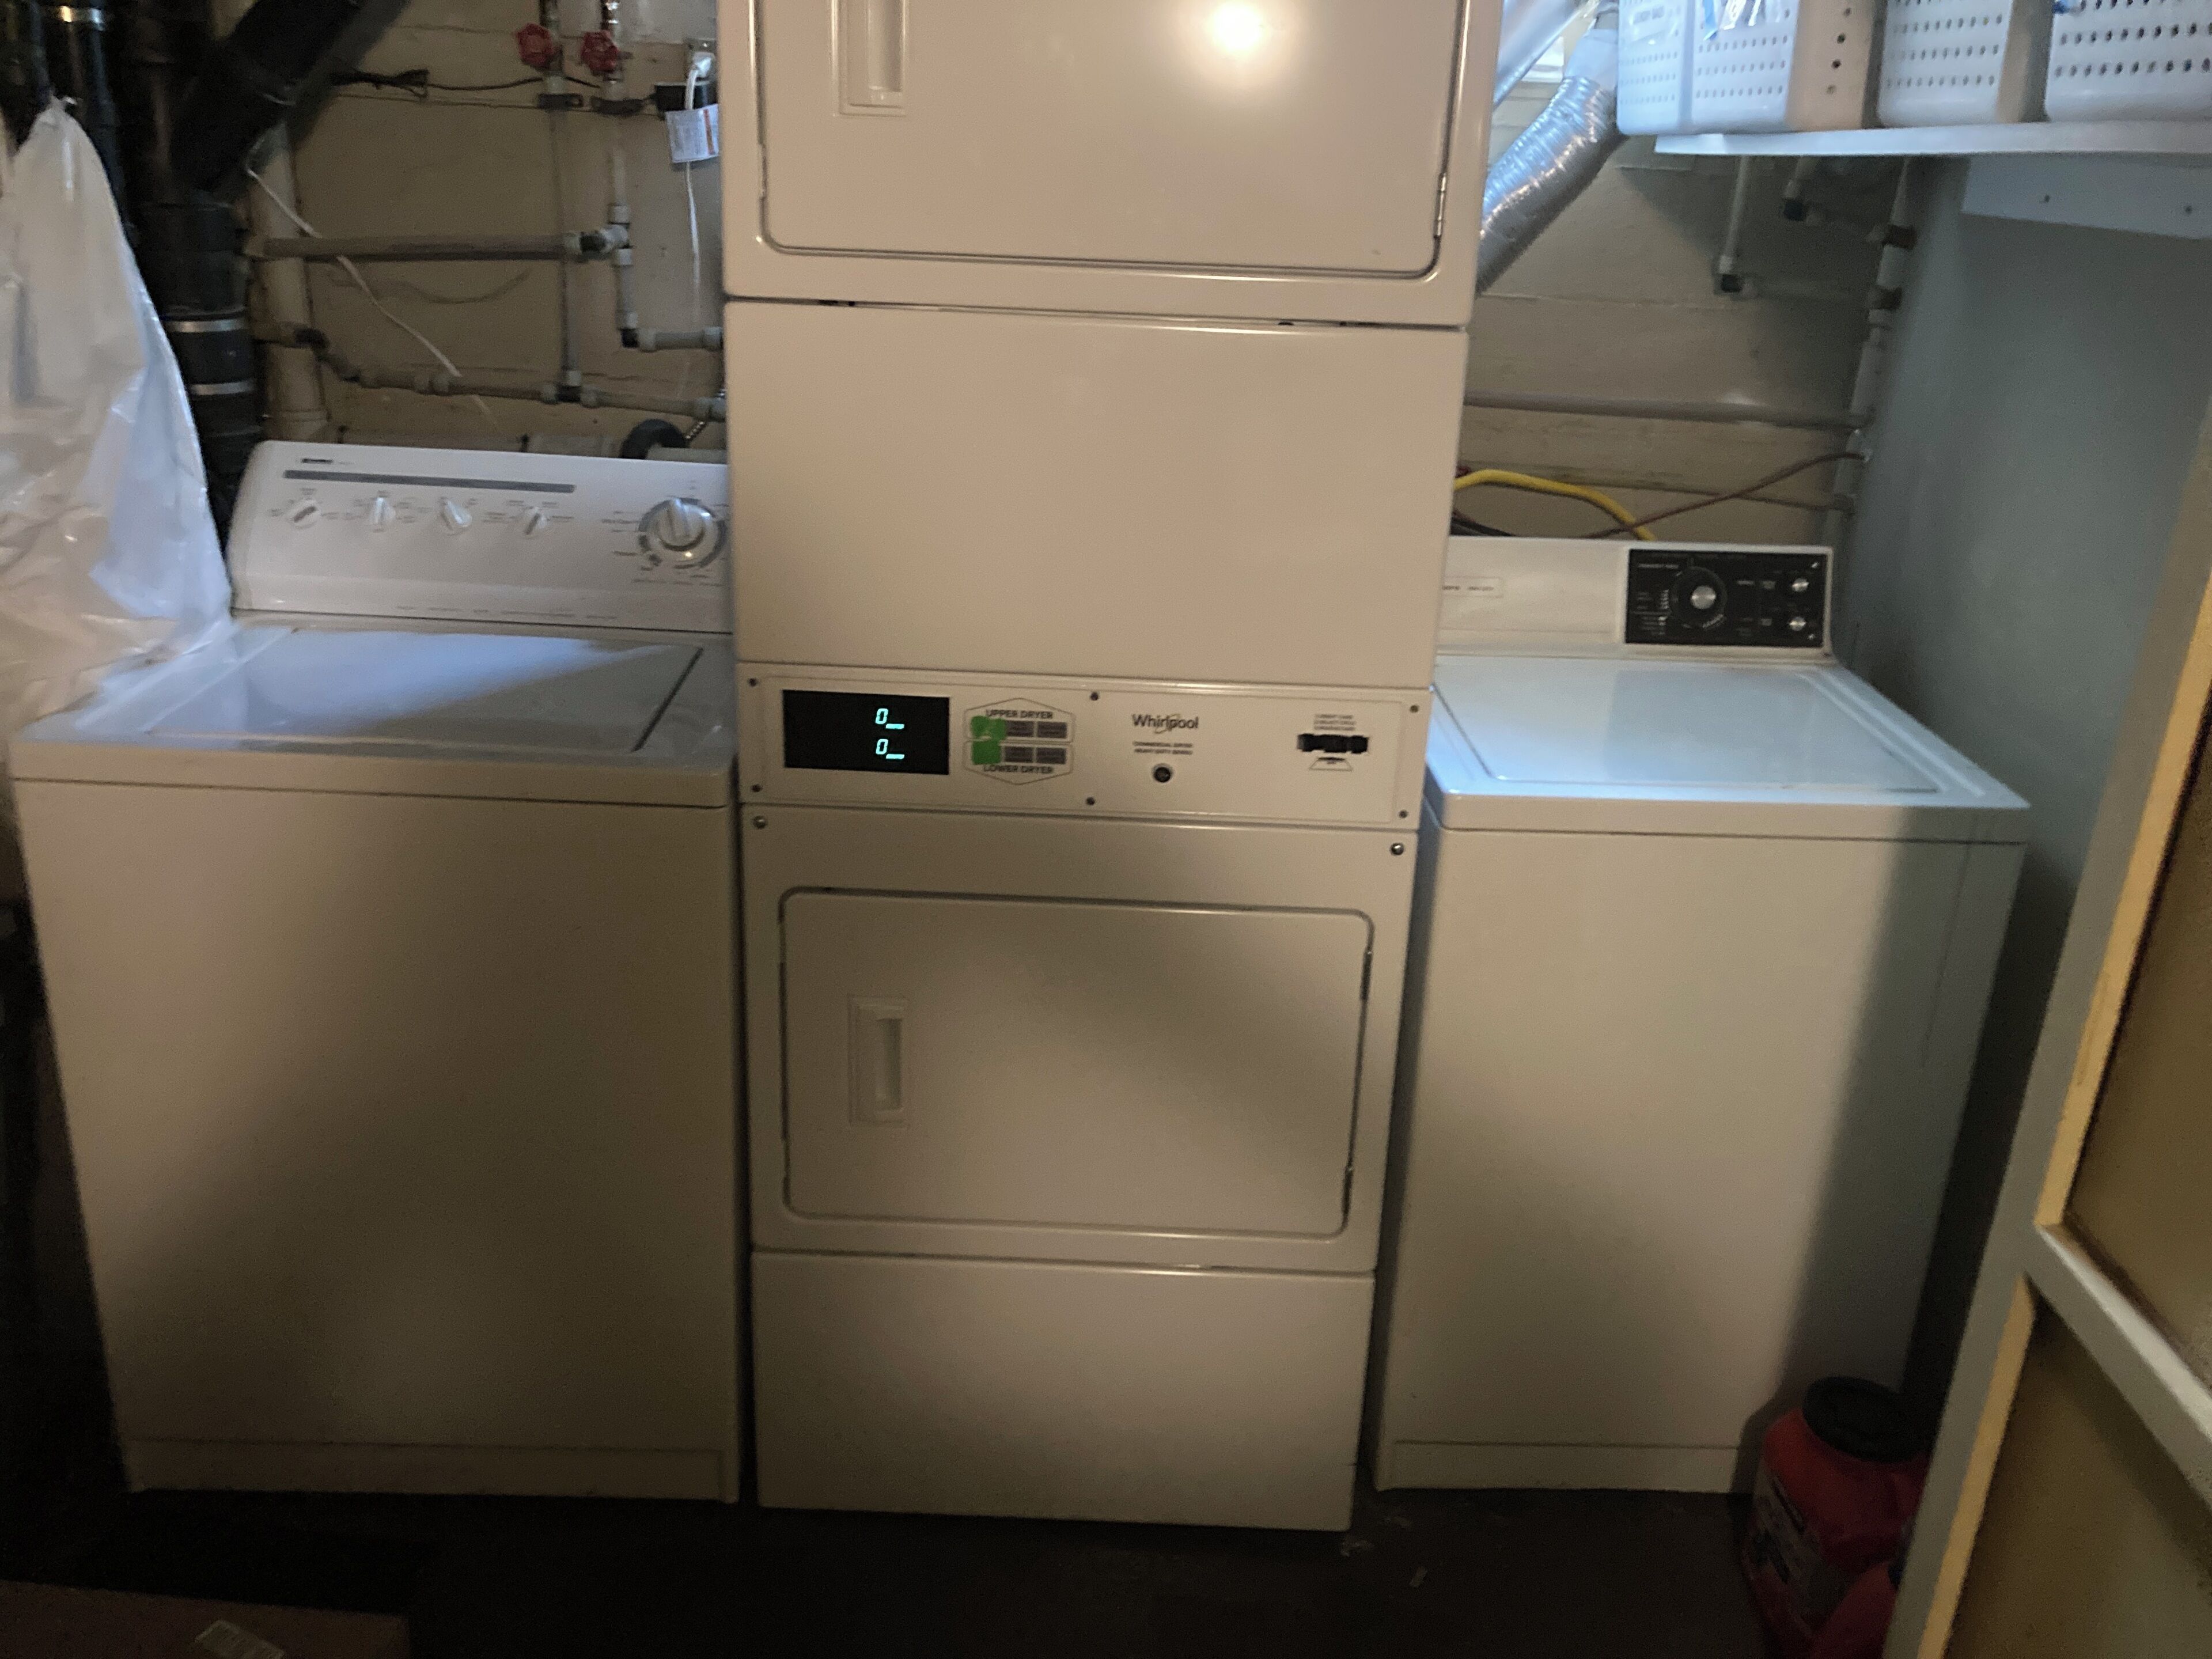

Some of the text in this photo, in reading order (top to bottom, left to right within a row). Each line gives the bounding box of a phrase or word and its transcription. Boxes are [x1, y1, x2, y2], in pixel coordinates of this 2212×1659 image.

[986, 709, 1054, 719] UPPER DRYER
[1131, 714, 1199, 731] Whirlpool
[983, 764, 1053, 774] LOWER DRYER
